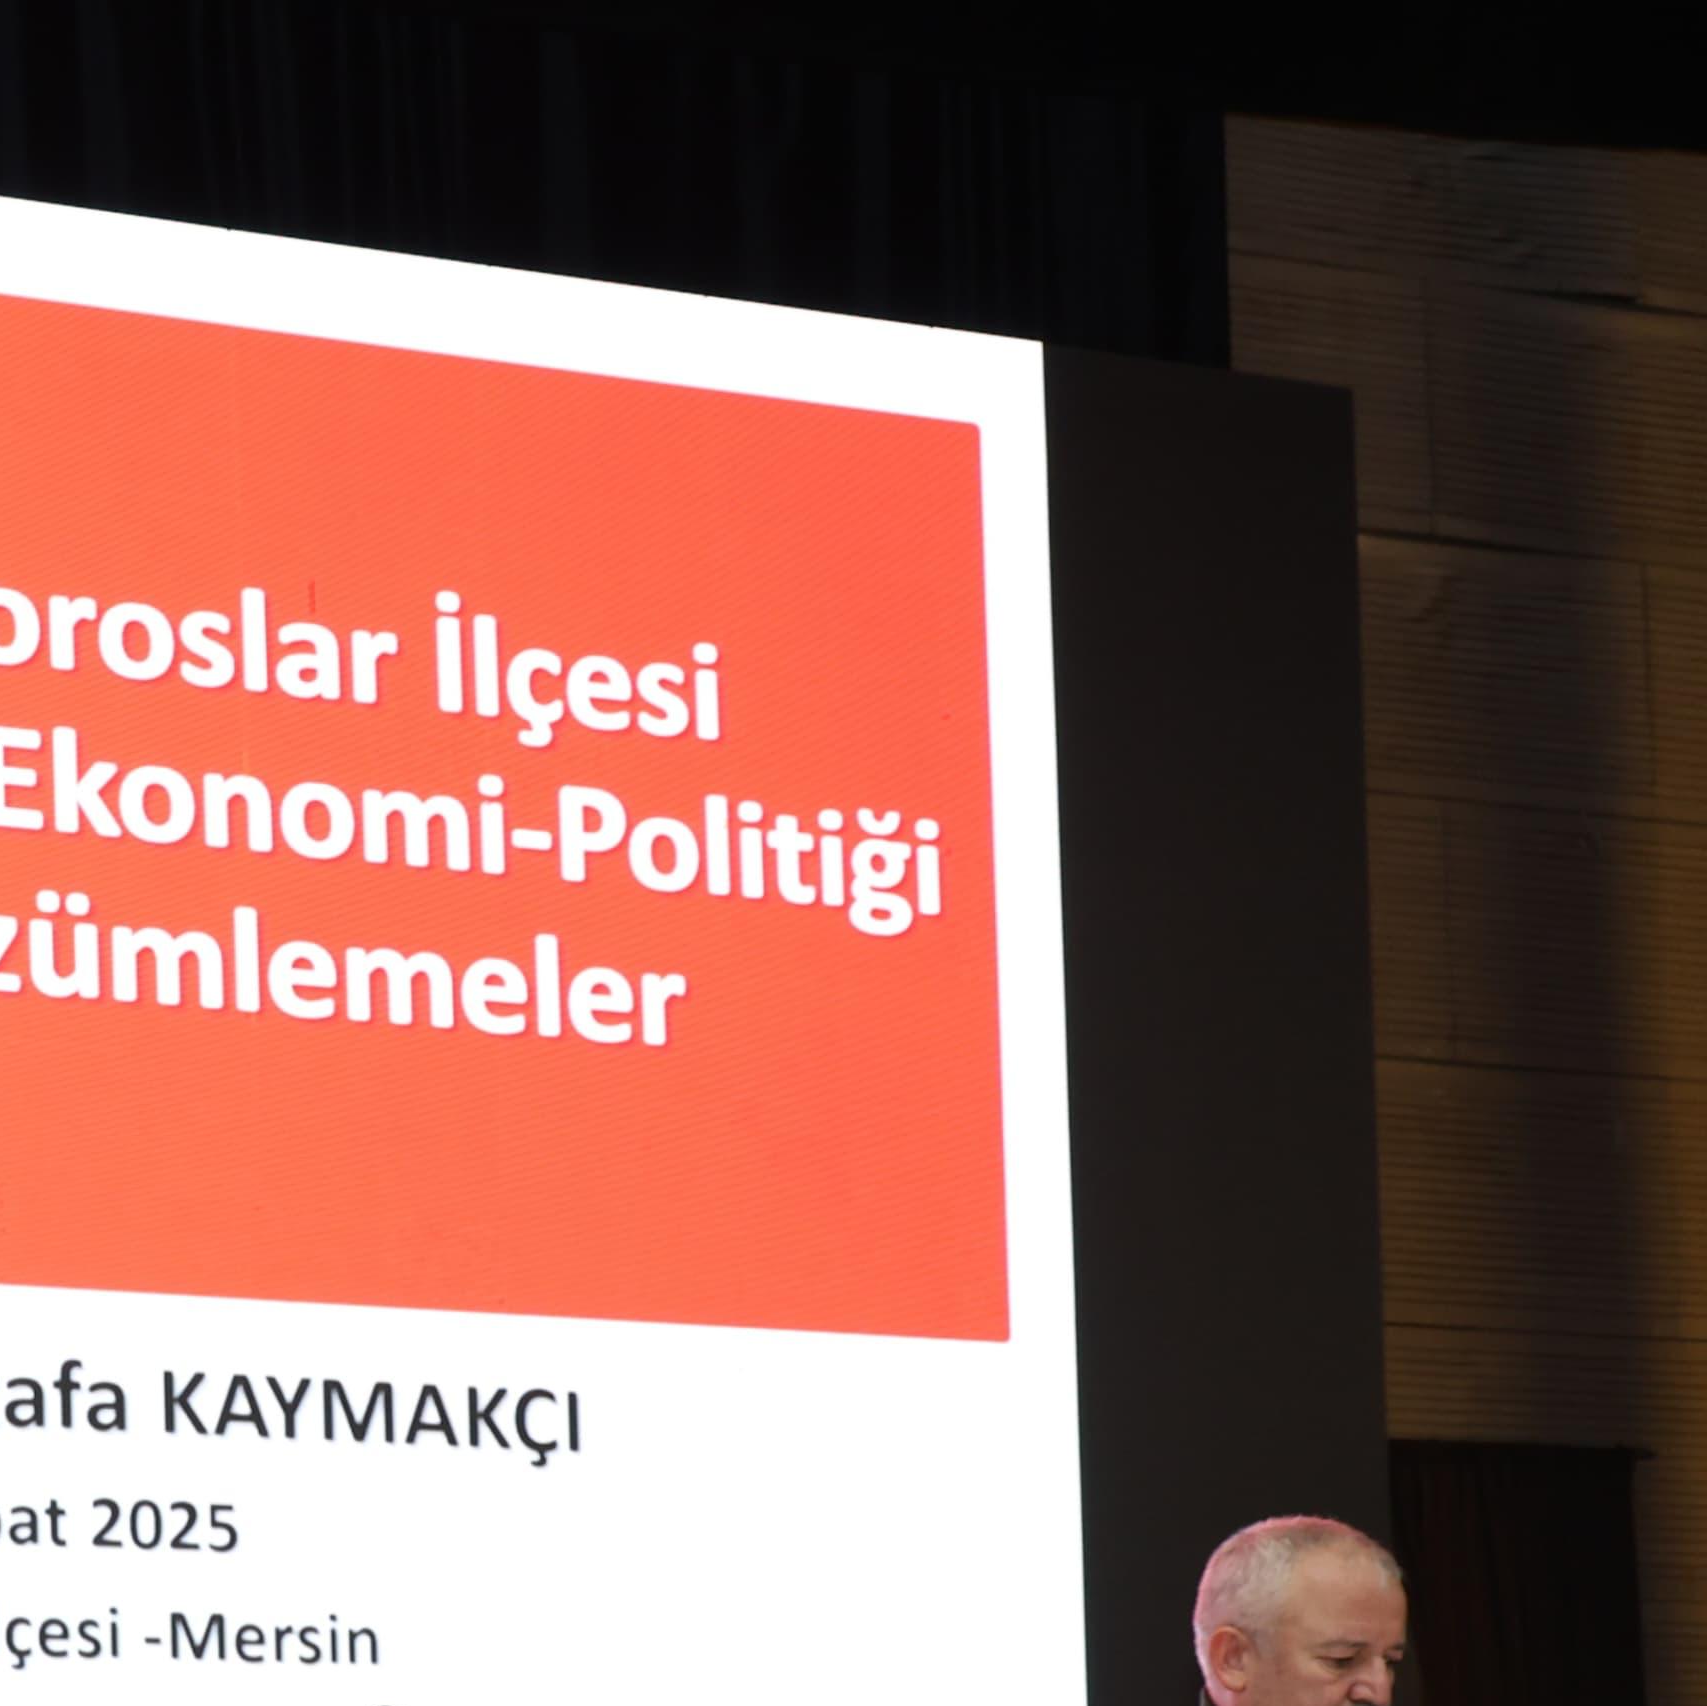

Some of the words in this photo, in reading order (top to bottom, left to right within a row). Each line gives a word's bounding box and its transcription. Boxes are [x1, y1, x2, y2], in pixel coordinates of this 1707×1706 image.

[434, 590, 720, 747] İlçesi
[162, 1370, 580, 1468] KAYMAKÇI
[91, 1498, 239, 1553] 2025
[144, 1612, 379, 1664] -Mersin
